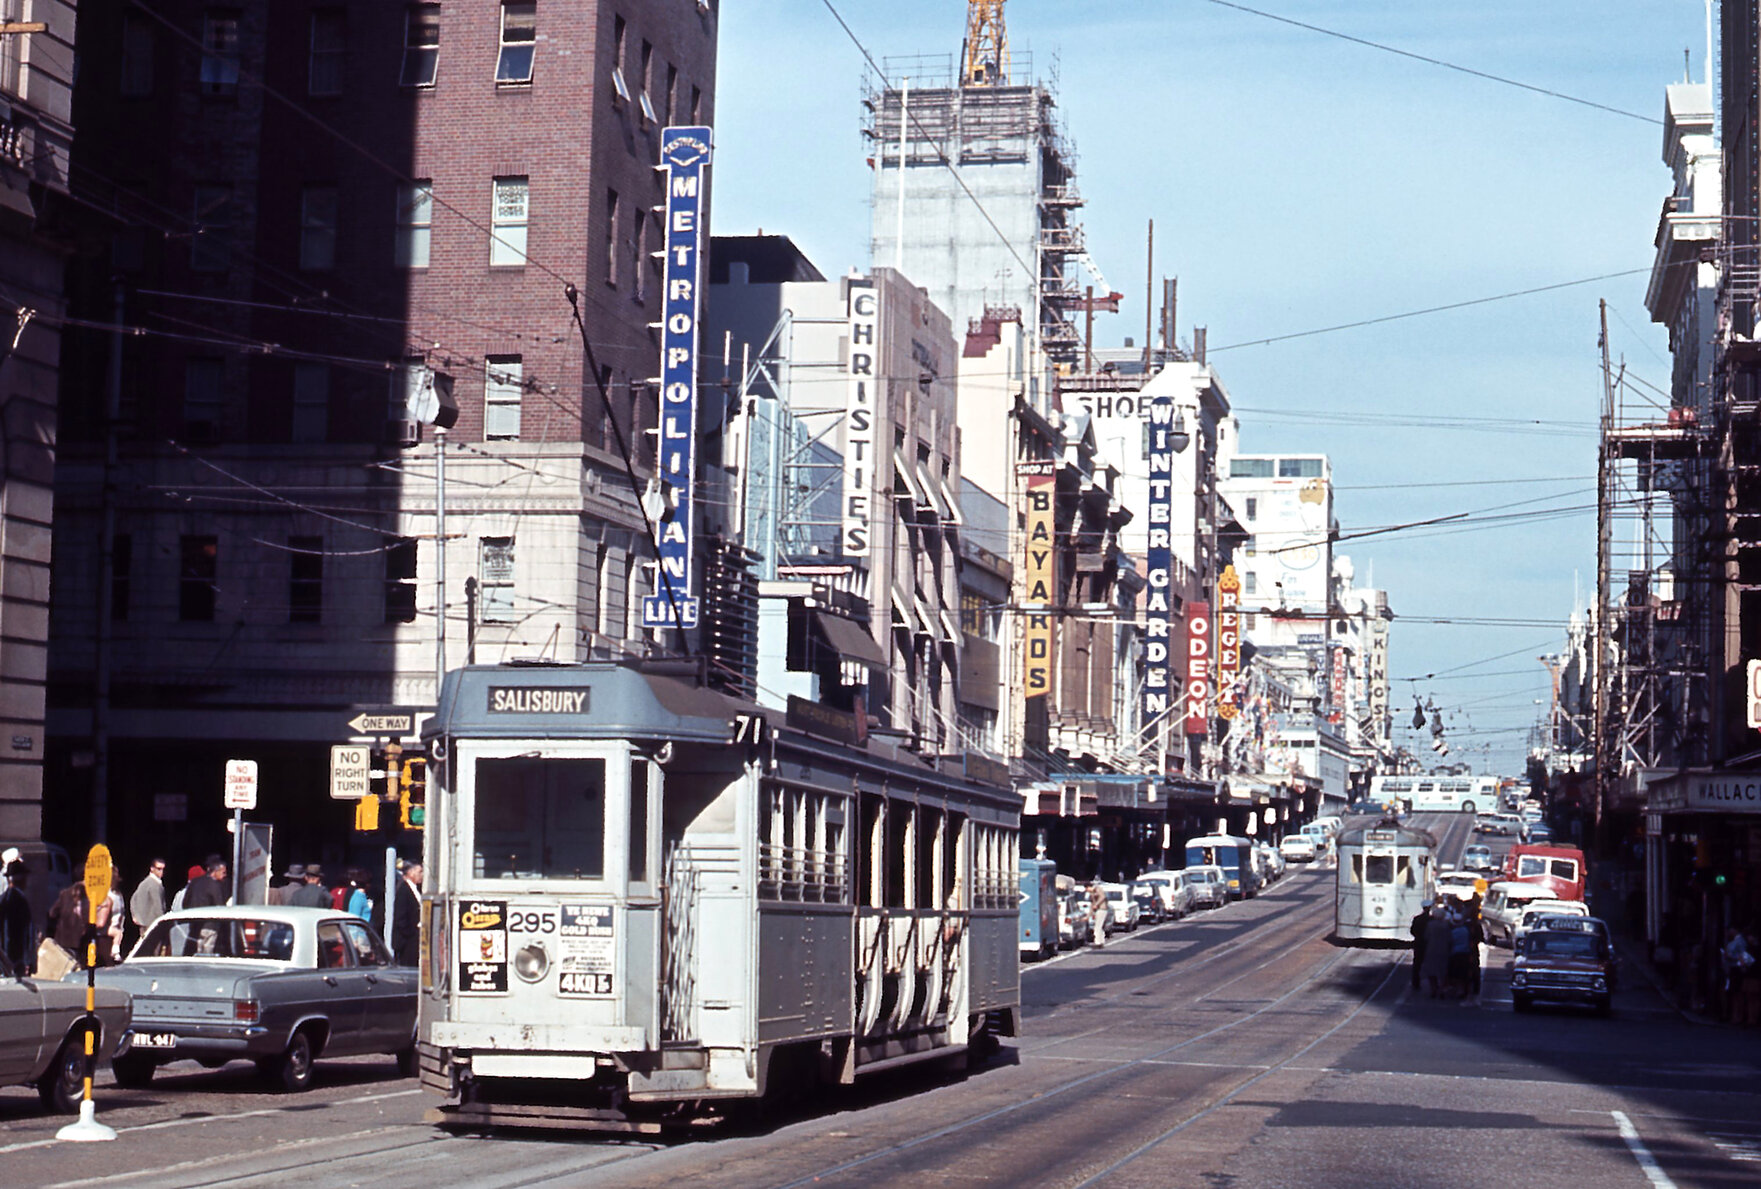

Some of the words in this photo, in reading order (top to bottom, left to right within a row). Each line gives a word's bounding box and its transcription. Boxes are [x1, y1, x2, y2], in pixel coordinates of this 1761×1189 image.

[660, 176, 698, 578] METROPOLITAN
[847, 293, 876, 552] CHRISTIES
[1016, 464, 1041, 475] SHOP
[1041, 463, 1054, 474] AT
[1149, 404, 1173, 548] WINTER
[1029, 491, 1050, 689] BAYARDS
[645, 601, 697, 622] LIFE
[1146, 568, 1169, 713] GARDEN
[1221, 593, 1238, 702] REGENT
[1187, 617, 1209, 718] ODEON
[494, 689, 586, 713] SALISBURY
[361, 718, 384, 729] ONE
[386, 717, 408, 729] WAY
[735, 715, 761, 744] 71
[340, 751, 361, 764] NO
[236, 765, 248, 774] NO
[335, 767, 365, 778] RIGHT
[337, 781, 364, 791] TURN
[1699, 783, 1761, 801] WALLAC
[86, 854, 109, 869] SAFETY
[89, 874, 105, 887] ZONE
[509, 911, 556, 934] 295
[561, 974, 596, 993] 4KQ
